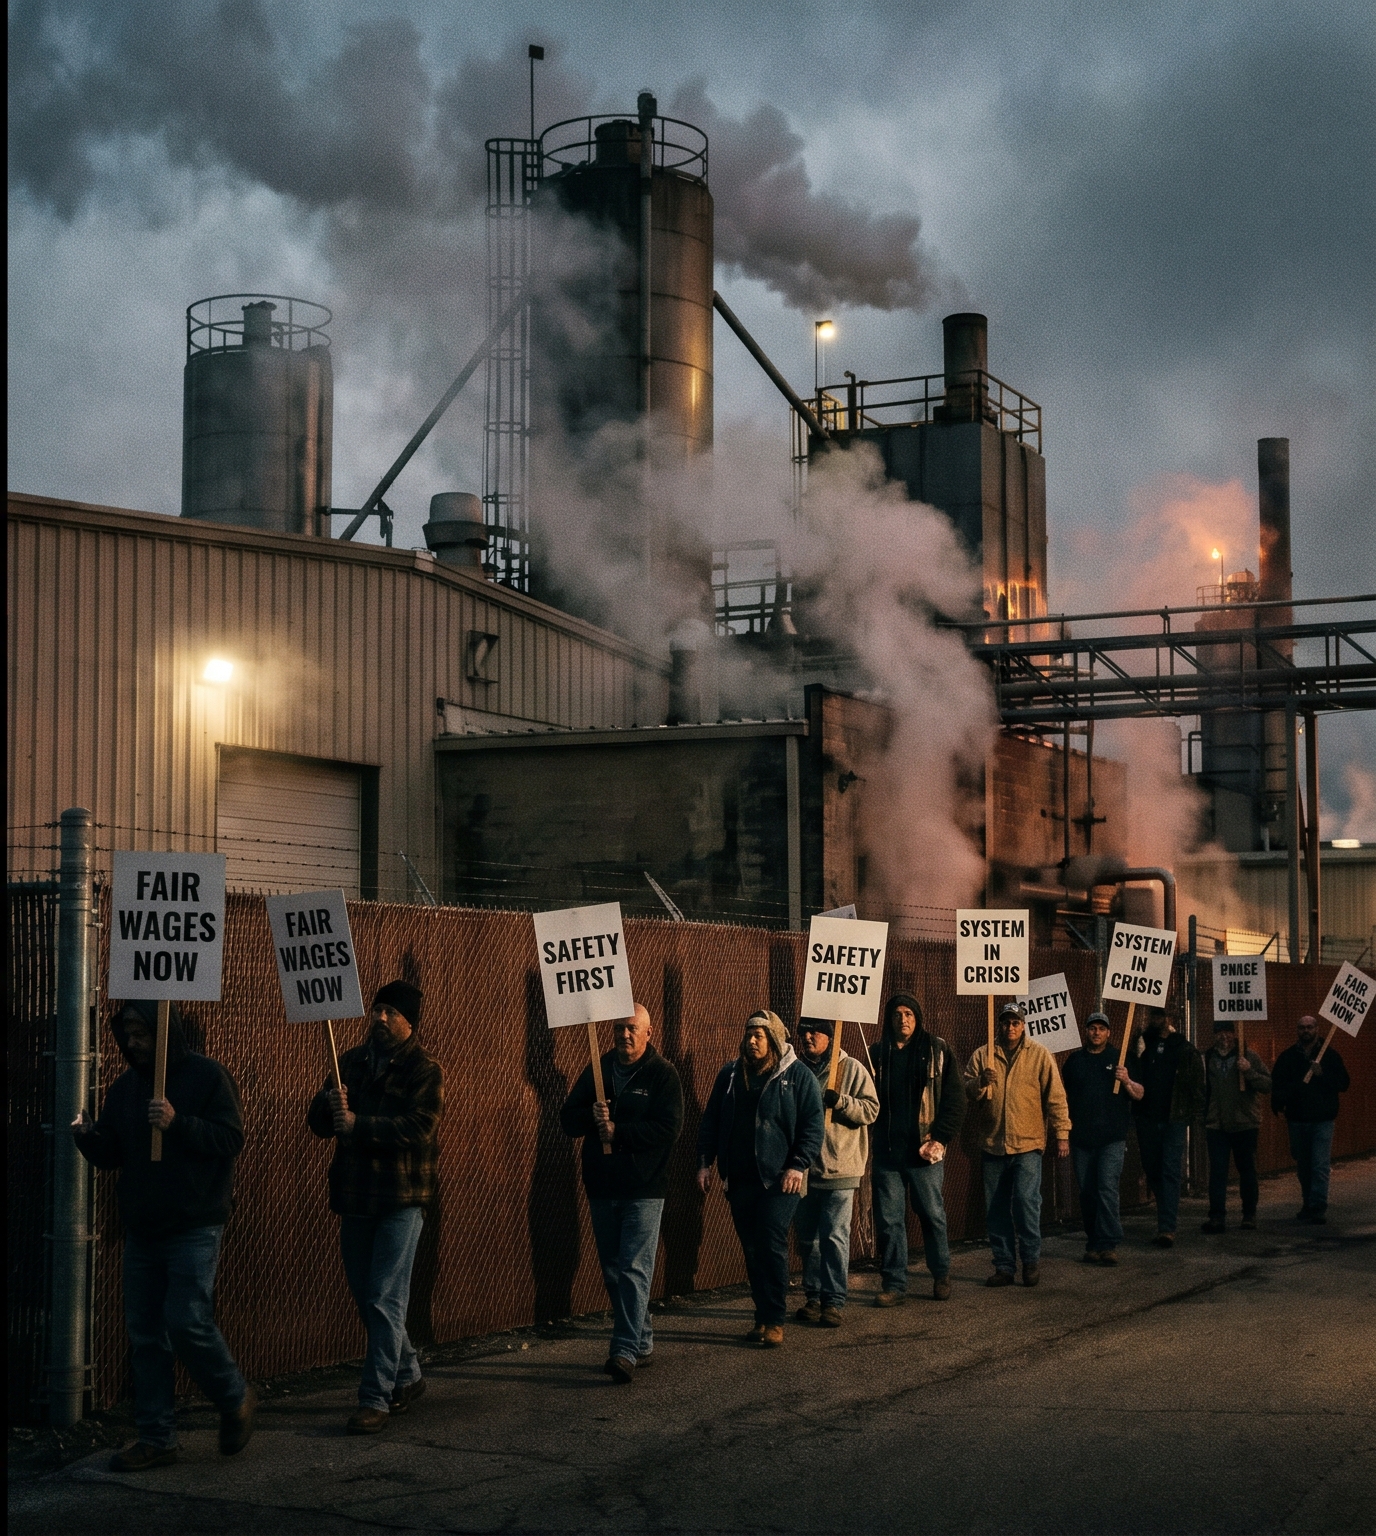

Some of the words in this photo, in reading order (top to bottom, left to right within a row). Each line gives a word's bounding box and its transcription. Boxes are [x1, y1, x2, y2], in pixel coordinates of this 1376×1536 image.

[136, 871, 200, 902] FAIR
[119, 910, 216, 942] WAGES
[285, 908, 333, 938] FAIR
[960, 920, 1024, 938] SYSTEM
[543, 932, 619, 964] SAFETY
[984, 944, 1000, 961] IN
[1114, 931, 1172, 955] SYSTEM
[133, 950, 198, 981] NOW
[279, 941, 350, 972] WAGES
[811, 943, 882, 968] SAFETY
[1131, 955, 1148, 972] IN
[556, 965, 615, 994] FIRST
[816, 972, 870, 995] FIRST
[964, 966, 1020, 983] CRISIS
[1110, 972, 1163, 996] CRISIS
[1344, 973, 1368, 997] FAIR
[296, 975, 342, 1005] NOW
[1018, 991, 1068, 1016] SAFETY
[1330, 1001, 1356, 1025] NOW
[1027, 1013, 1067, 1036] FIRST
